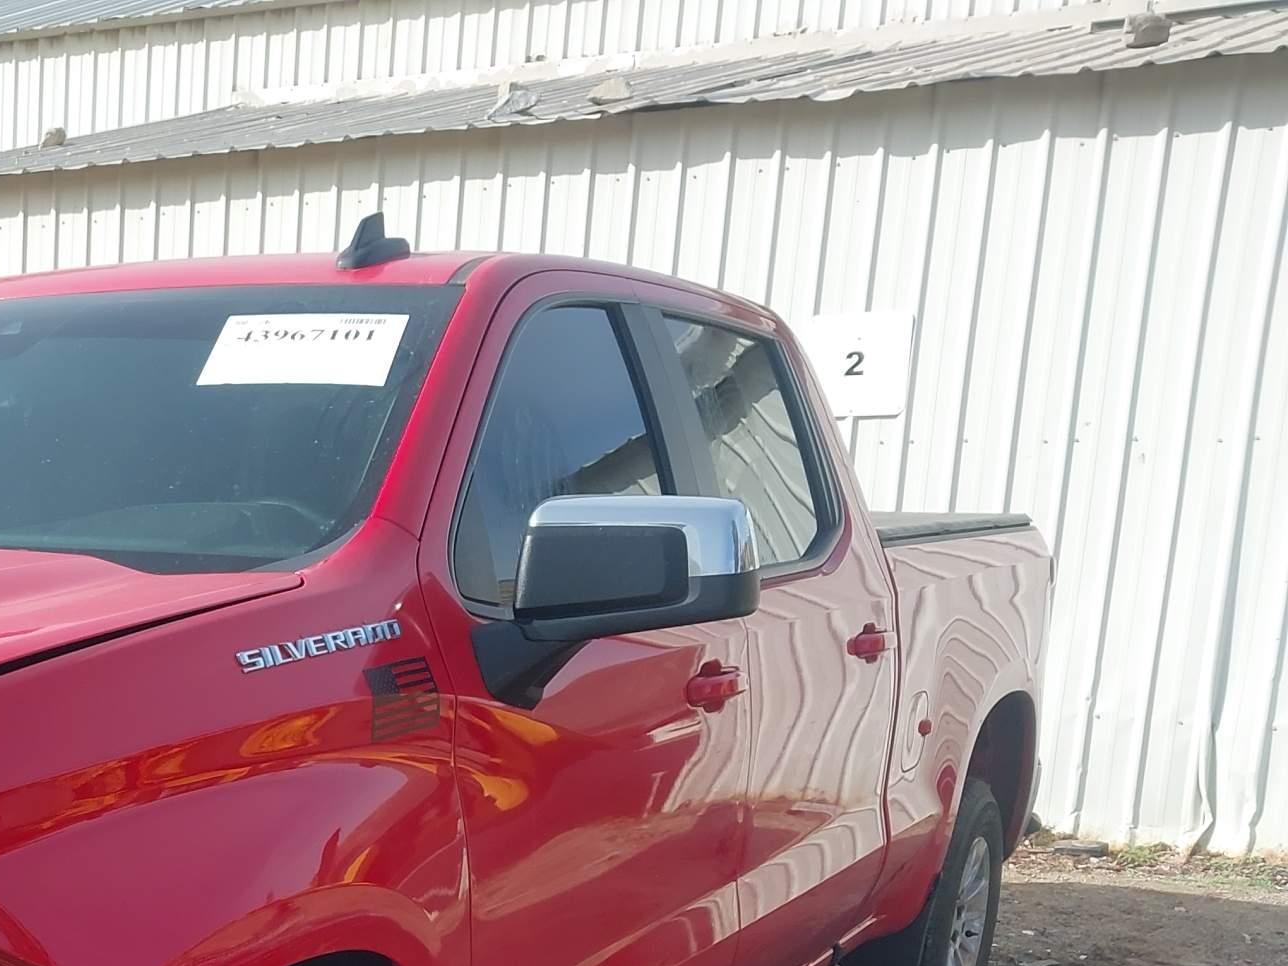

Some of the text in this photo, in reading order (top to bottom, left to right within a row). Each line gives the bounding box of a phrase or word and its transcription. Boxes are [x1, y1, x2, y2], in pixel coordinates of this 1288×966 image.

[237, 328, 375, 343] 43967101
[844, 351, 865, 376] 2
[236, 619, 402, 673] SILVERADO
